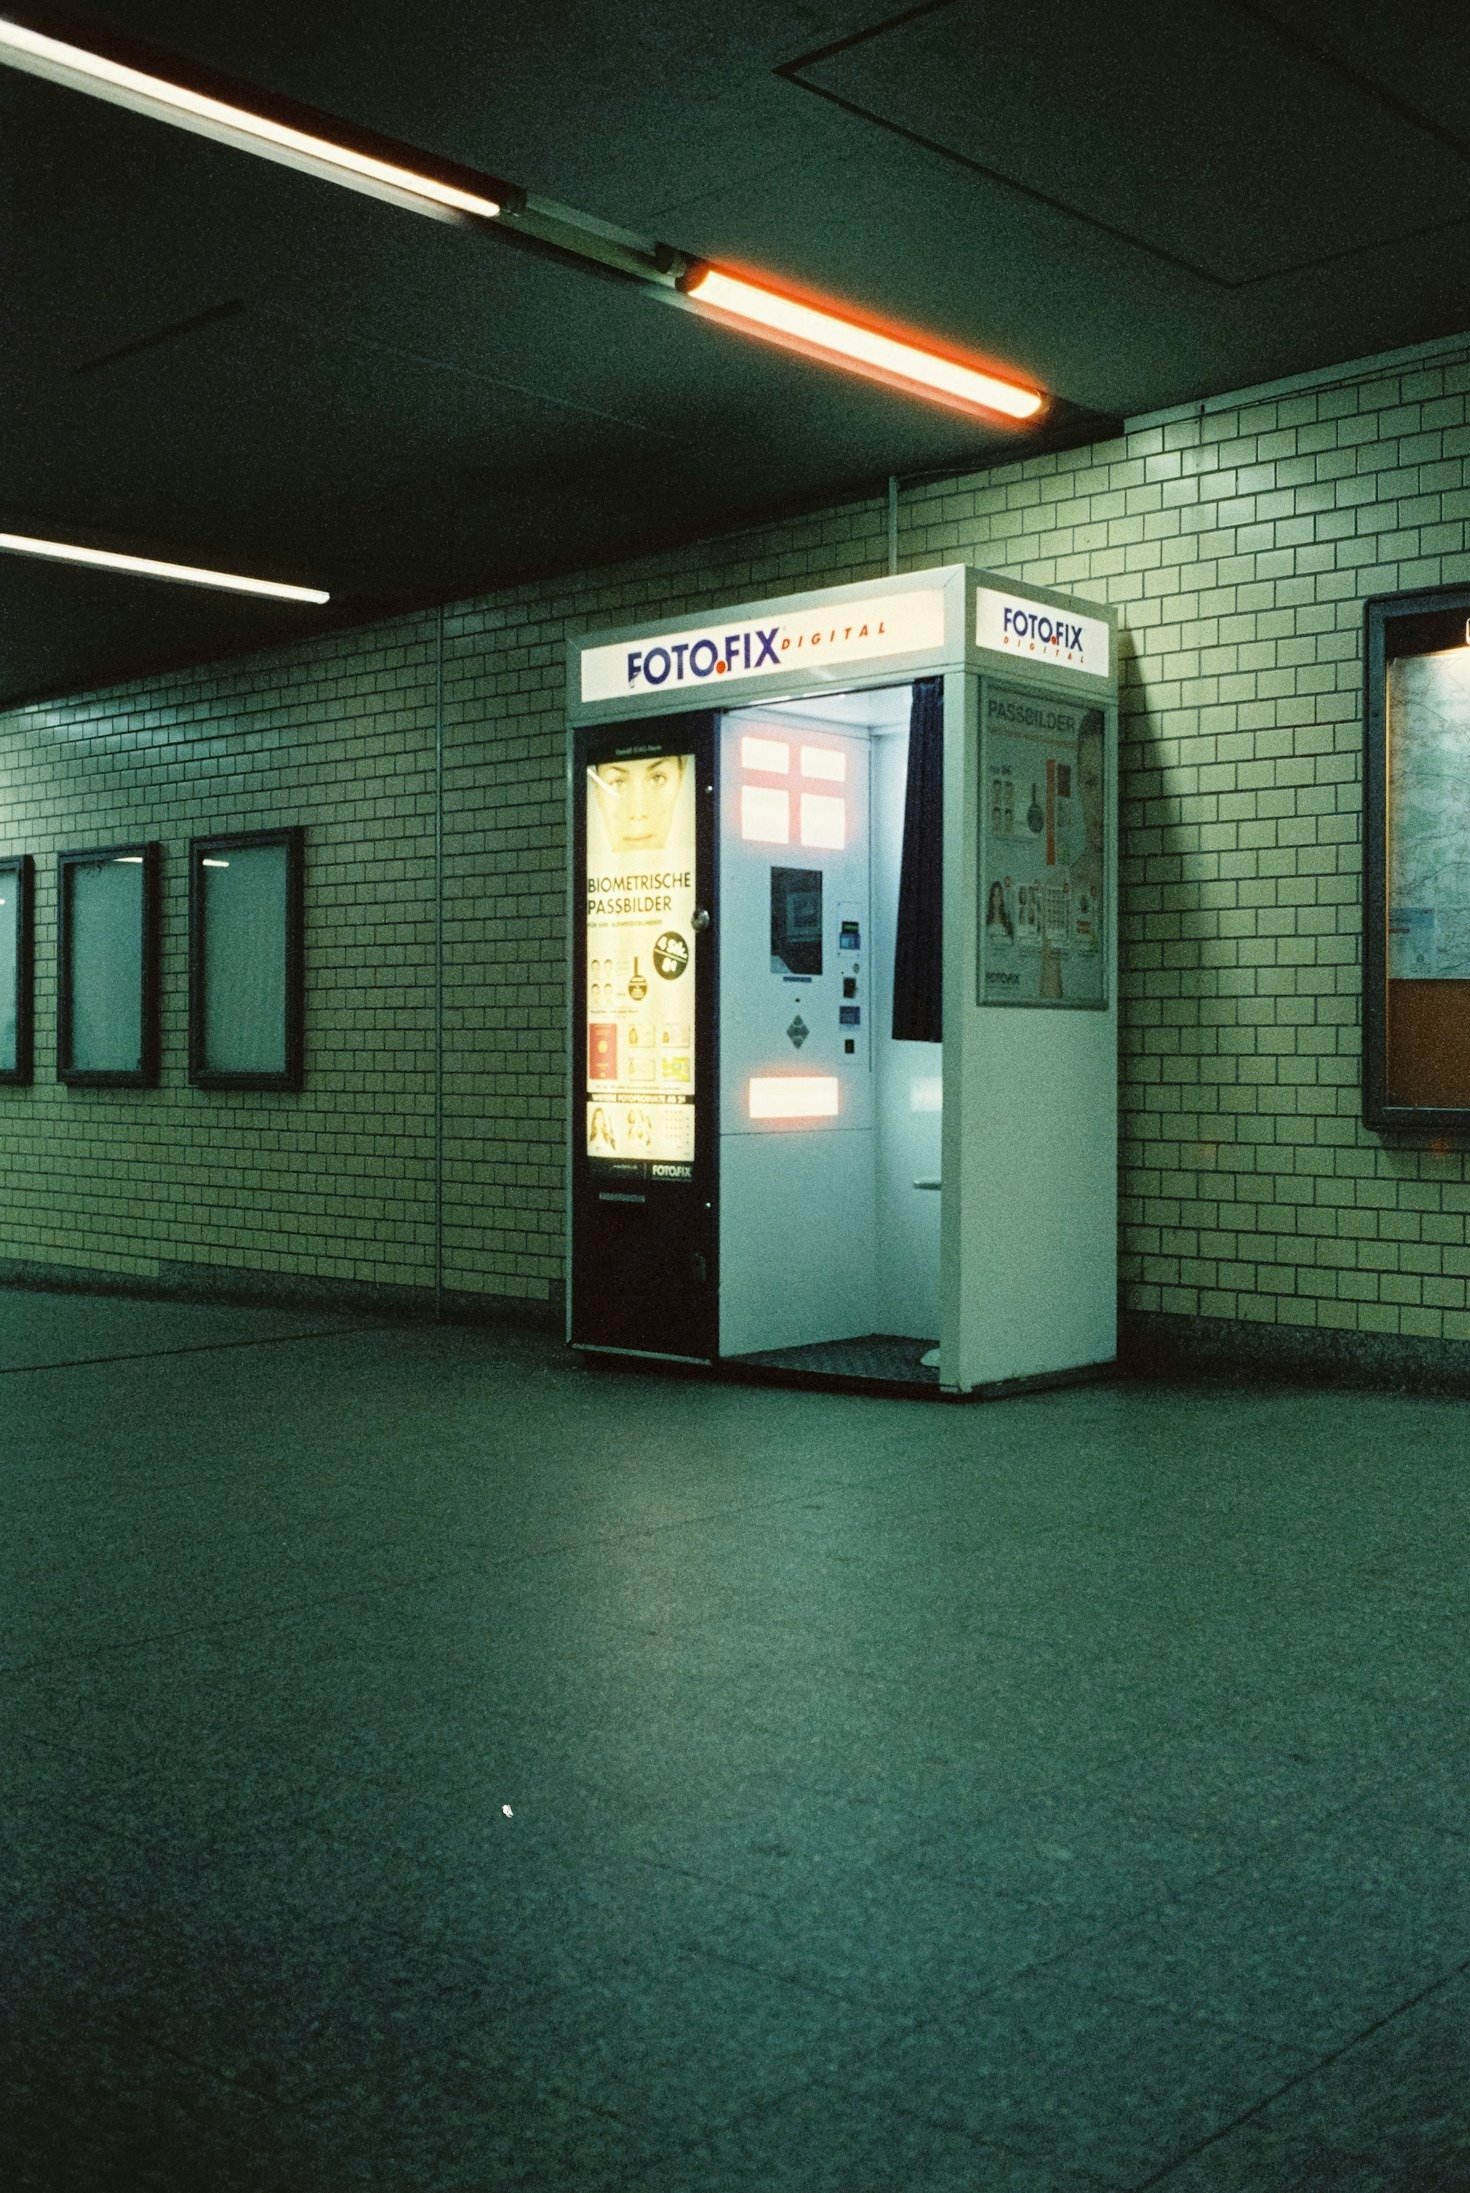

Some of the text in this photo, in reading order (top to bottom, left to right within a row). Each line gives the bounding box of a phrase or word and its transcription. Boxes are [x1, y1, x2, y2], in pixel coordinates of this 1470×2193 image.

[781, 621, 885, 651] DIGITAL
[1003, 635, 1084, 664] DIGITAL
[988, 701, 1076, 732] PASSBILDER
[588, 872, 691, 893] BIOMETRISCHE
[588, 895, 672, 915] PASSBILDER
